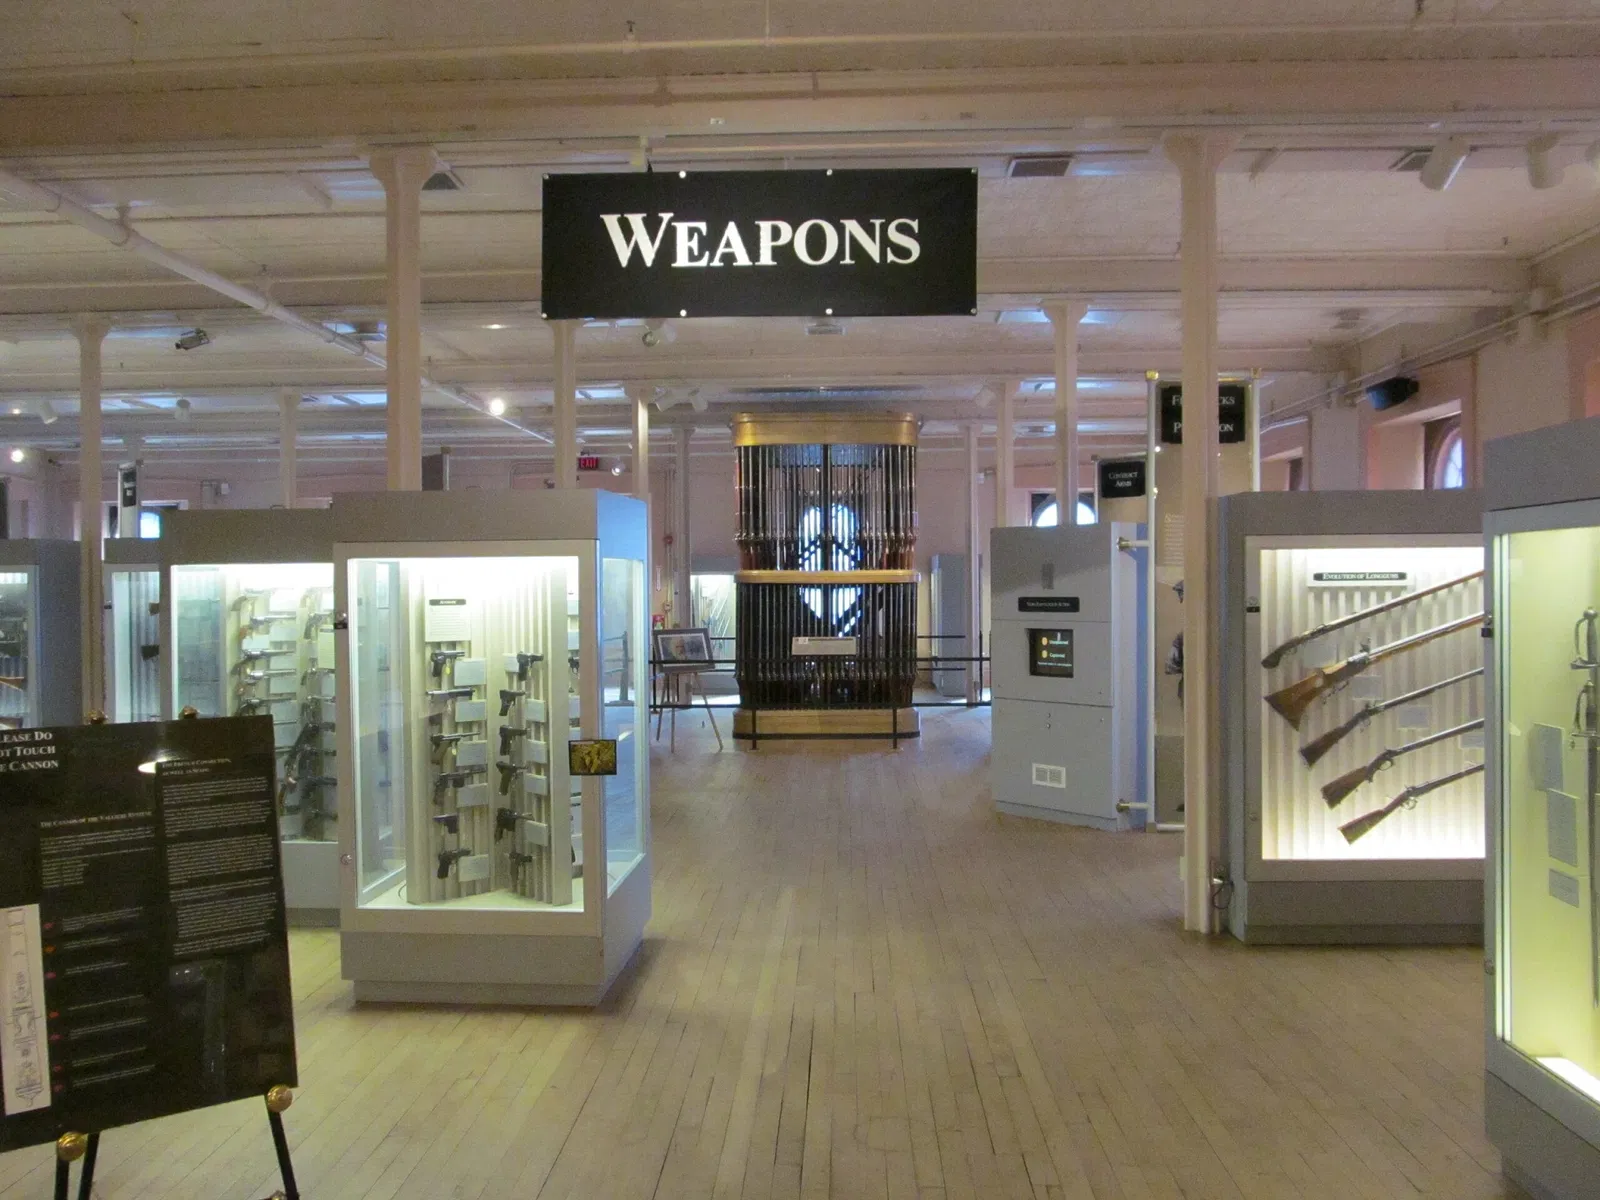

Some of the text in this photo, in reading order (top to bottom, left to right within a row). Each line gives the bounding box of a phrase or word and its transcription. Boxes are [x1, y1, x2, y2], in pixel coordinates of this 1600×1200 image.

[600, 212, 921, 269] WEAPONS
[580, 458, 597, 468] EXIT
[34, 731, 53, 741] DO
[14, 745, 56, 757] TOUCH
[9, 760, 59, 771] CANNON
